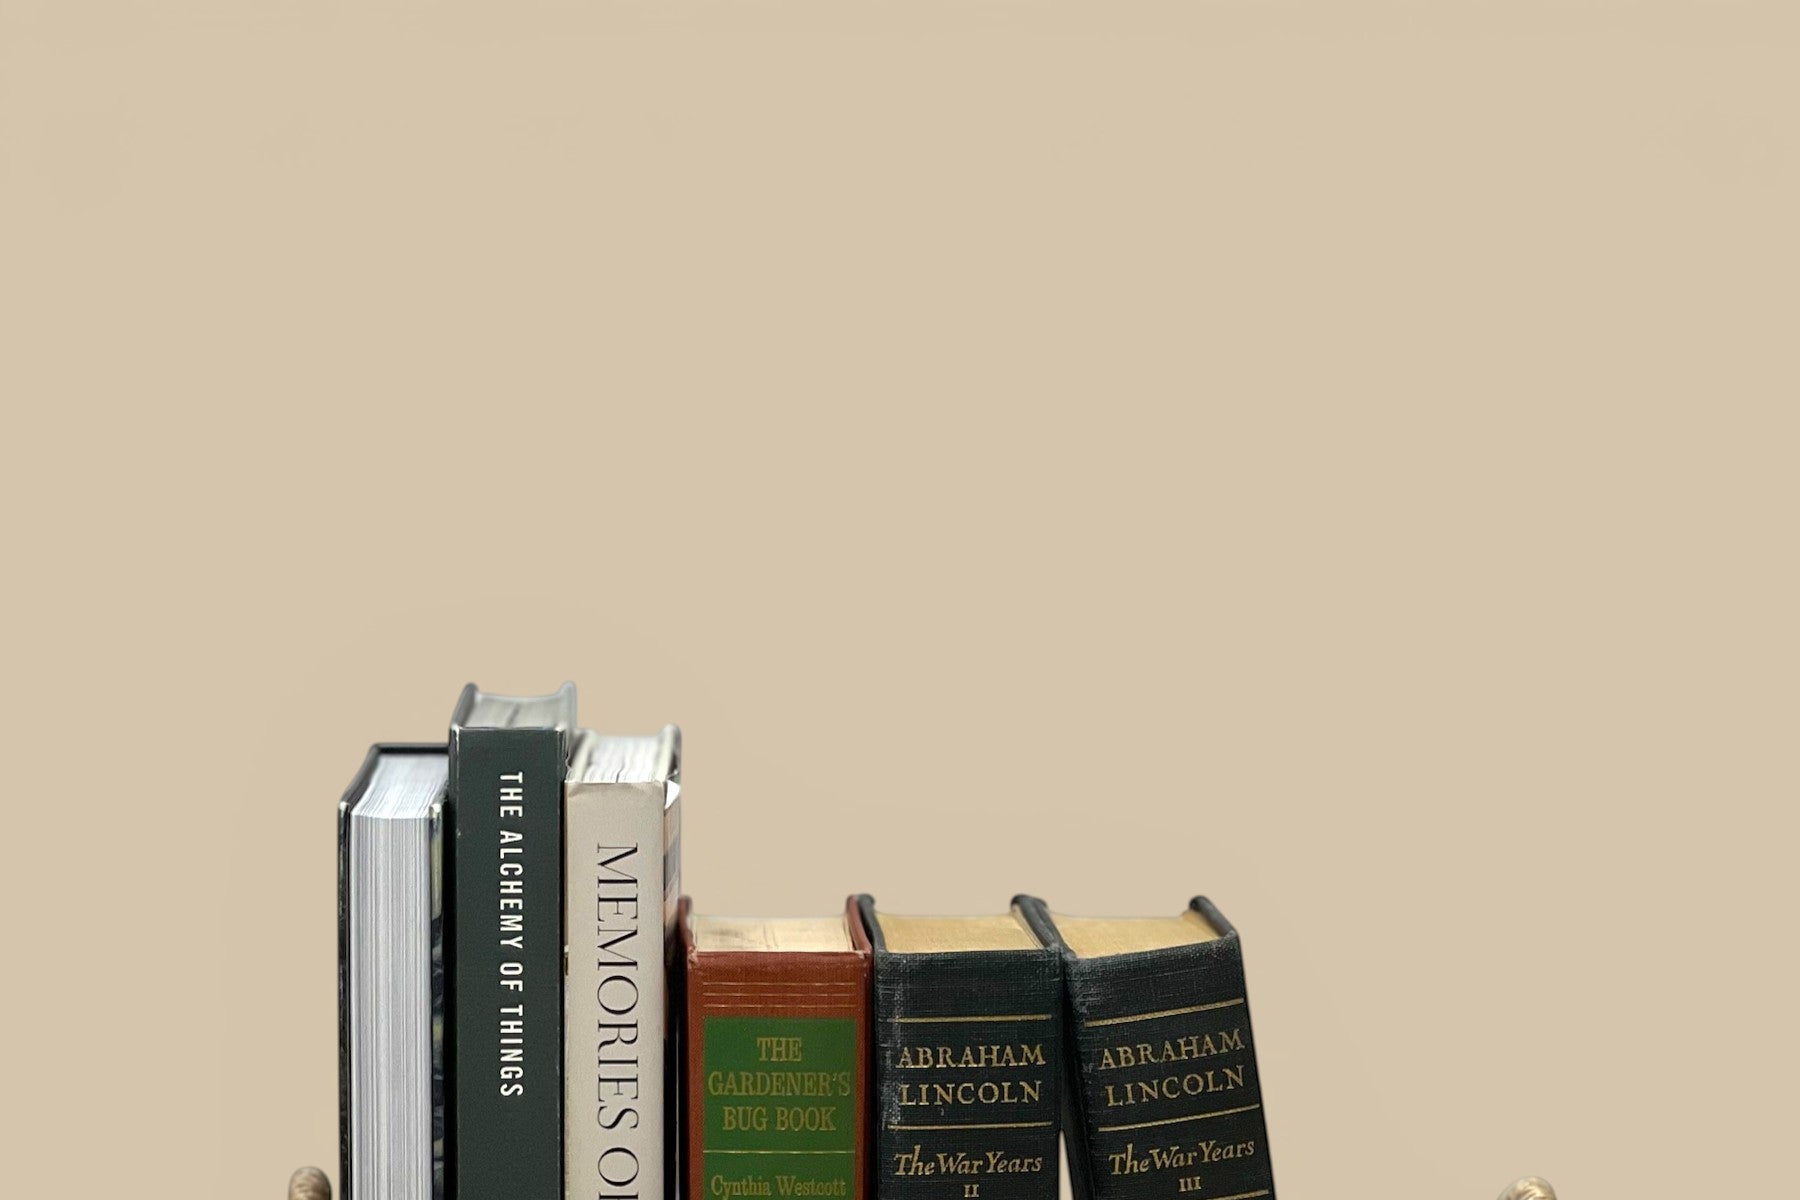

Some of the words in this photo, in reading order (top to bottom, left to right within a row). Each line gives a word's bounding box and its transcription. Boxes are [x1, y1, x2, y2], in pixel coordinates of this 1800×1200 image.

[499, 771, 523, 818] THE
[499, 830, 523, 949] ALCHEMY
[499, 962, 523, 992] OF
[596, 842, 640, 1130] MEMORIES
[499, 1004, 523, 1097] THINGS
[757, 1037, 802, 1062] THE
[895, 1043, 1046, 1069] ABRAHAM
[1099, 1028, 1246, 1070] ABRAHAM
[708, 1071, 851, 1097] GARDENER'S
[899, 1080, 1042, 1106] LINCOLN
[1105, 1064, 1245, 1107] LINCOLN
[723, 1106, 768, 1131] BUG
[775, 1106, 837, 1132] BOOK
[893, 1144, 935, 1176] The
[936, 1153, 983, 1175] War
[985, 1151, 1042, 1174] Years
[1108, 1143, 1150, 1175] The
[1149, 1145, 1198, 1170] War
[1198, 1139, 1255, 1165] Years
[776, 1175, 847, 1197] Westcott
[963, 1184, 980, 1198] II
[1178, 1176, 1202, 1192] III
